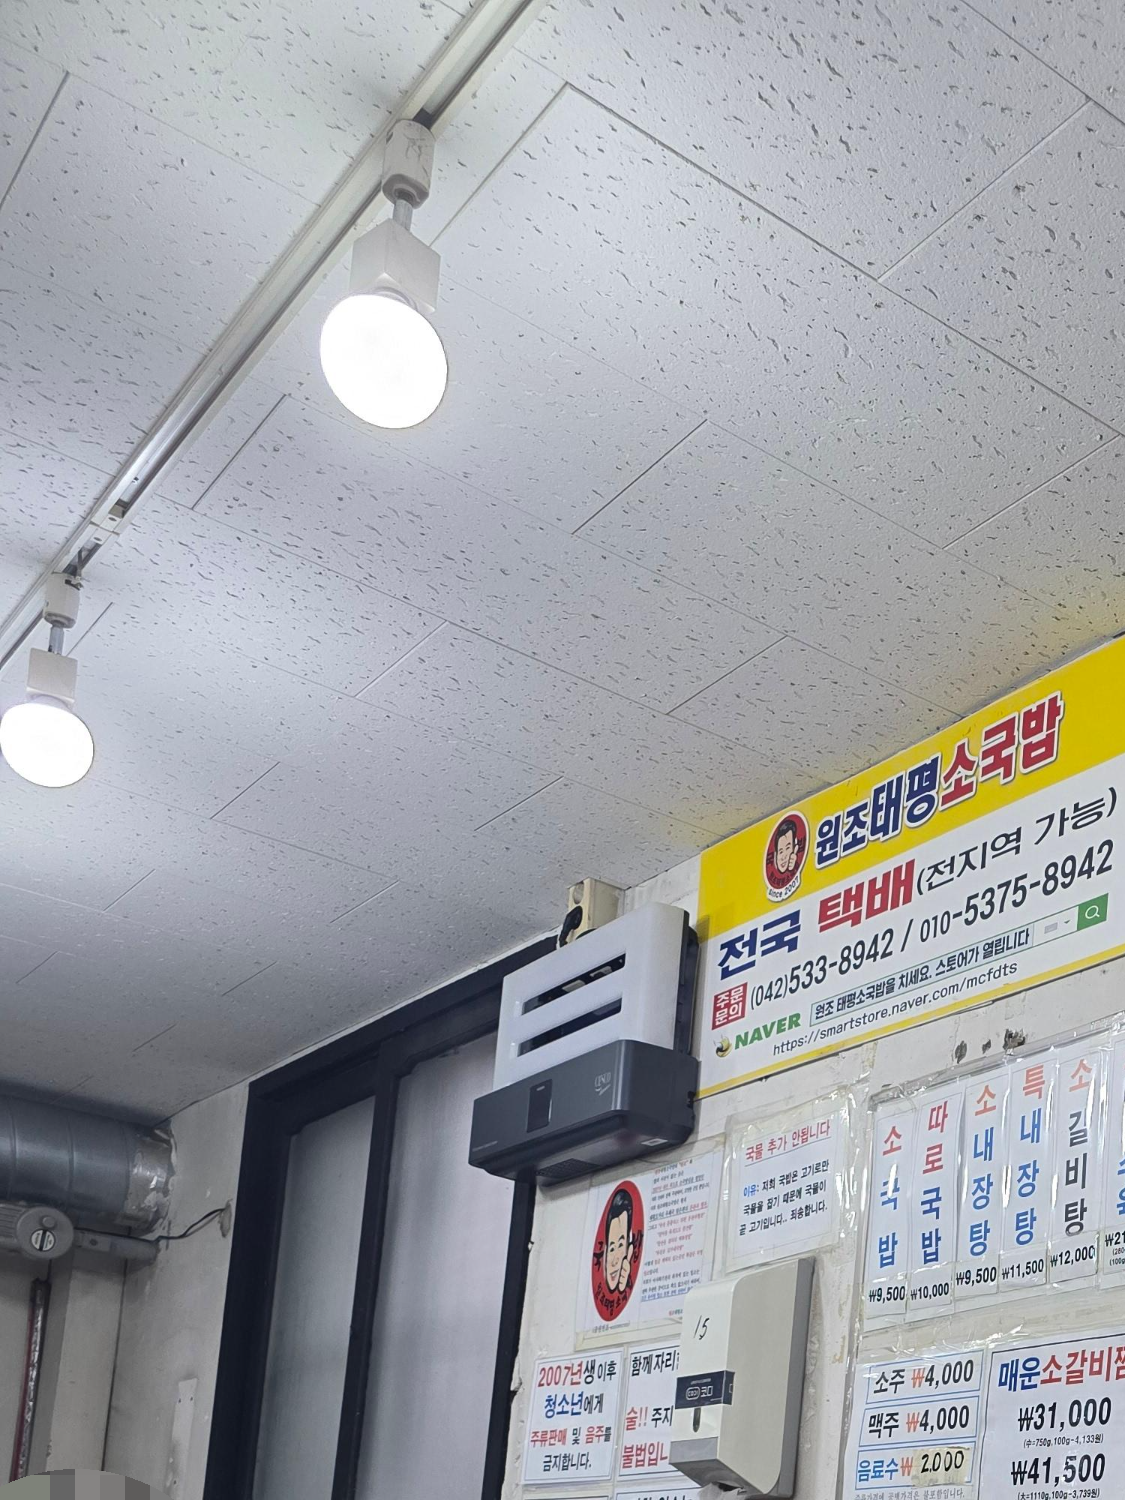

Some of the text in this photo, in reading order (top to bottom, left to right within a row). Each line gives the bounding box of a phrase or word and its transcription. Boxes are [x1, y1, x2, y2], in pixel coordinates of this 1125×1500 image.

[816, 693, 1063, 868] 원조태평소국밥
[718, 786, 1117, 981] 전국 가능)
[750, 928, 894, 1010] (042)533-8942
[919, 839, 1115, 943] 010-5375-8942
[815, 927, 1030, 1020] 원조 태평소국밥을 치세요. 스토어가 열립니다
[773, 961, 1018, 1056] https://smartstore.naver.com/mcfdts
[734, 1012, 801, 1050] NAVER
[745, 1119, 830, 1162] 국물 추가 안됩니다
[1015, 1064, 1046, 1246] 특내장탕
[762, 1178, 776, 1192] 저희
[920, 1101, 948, 1265] 따로국밥
[969, 1084, 997, 1257] 소내장탕
[956, 1266, 997, 1285] ₩9,500
[1002, 1259, 1044, 1280] ₩11,500
[693, 1314, 711, 1340] 15
[597, 1360, 617, 1382] 이후
[874, 1359, 974, 1394] 소주 ₩4,000
[544, 1391, 604, 1419] 청소년에게
[625, 1406, 648, 1431] 술!!
[868, 1405, 970, 1438] 맥주 ₩4,000
[1018, 1397, 1112, 1432] ₩31,000
[530, 1425, 612, 1448] 주류판매 및 음주를
[543, 1452, 592, 1472] 금지합니다.
[858, 1458, 898, 1482] 음료수
[1011, 1453, 1105, 1487] ₩41,500
